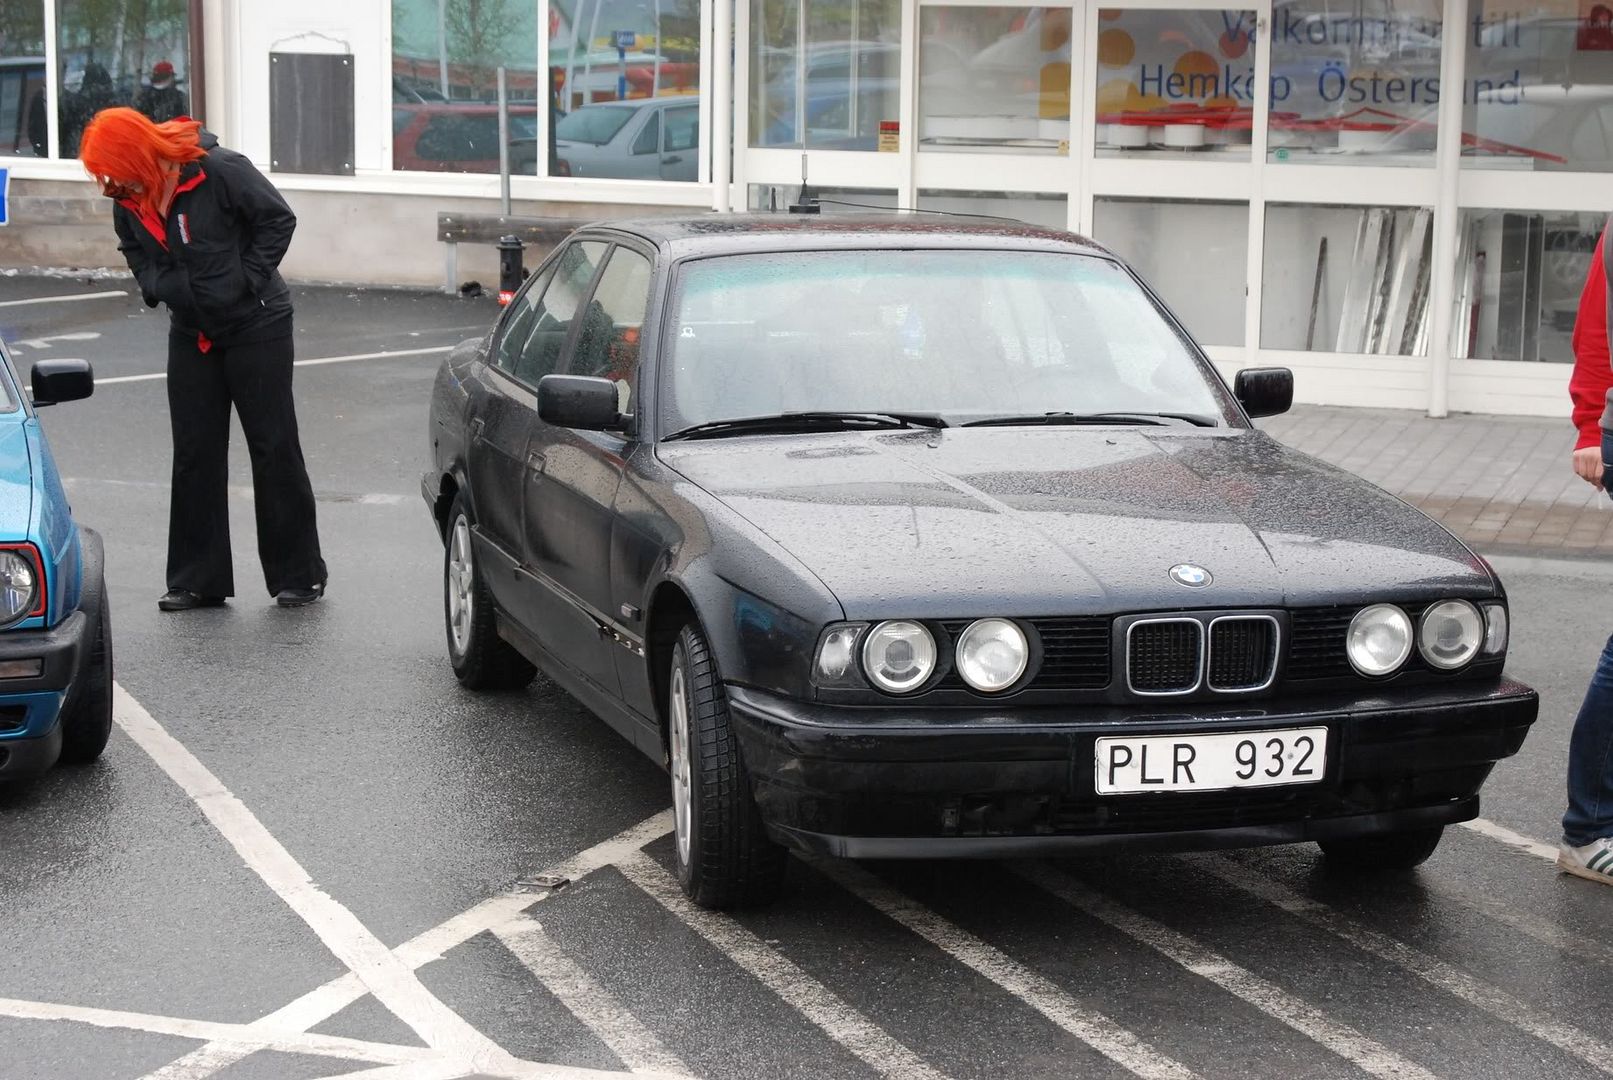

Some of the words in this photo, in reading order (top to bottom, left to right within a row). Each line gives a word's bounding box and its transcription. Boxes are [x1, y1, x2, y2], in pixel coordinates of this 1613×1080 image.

[1221, 9, 1441, 45] Vlkomm
[1318, 61, 1519, 105] Östersnd
[1109, 743, 1197, 785] PLR
[1235, 736, 1314, 780] 932
